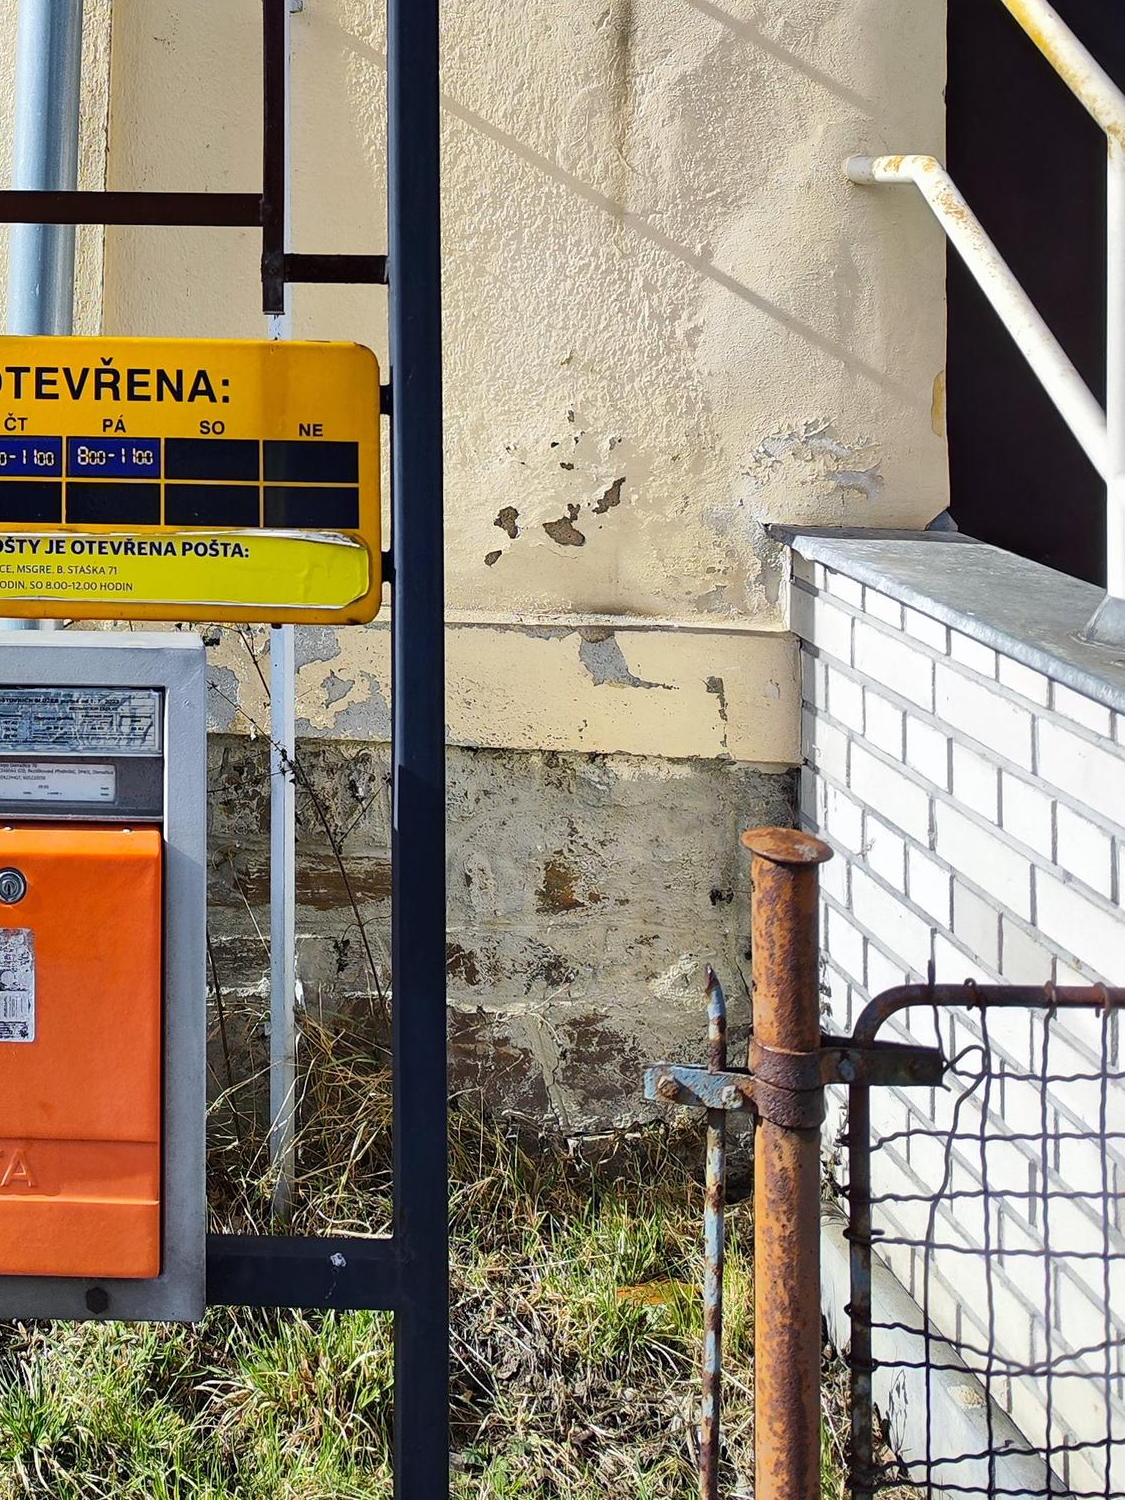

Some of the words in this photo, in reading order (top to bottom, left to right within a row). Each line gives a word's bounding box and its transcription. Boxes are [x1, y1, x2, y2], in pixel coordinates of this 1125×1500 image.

[4, 412, 28, 431] ČT
[102, 414, 126, 433] PÁ
[199, 420, 225, 435] SO
[298, 423, 324, 437] NE
[45, 539, 66, 555] JE
[71, 538, 177, 557] OTEVŘENA
[181, 539, 249, 558] POŠTA:
[67, 564, 106, 575] STAŠKA
[108, 565, 118, 575] 71
[30, 581, 43, 590] SO
[45, 581, 97, 591] 8.00-12.00
[99, 582, 133, 591] HODIN
